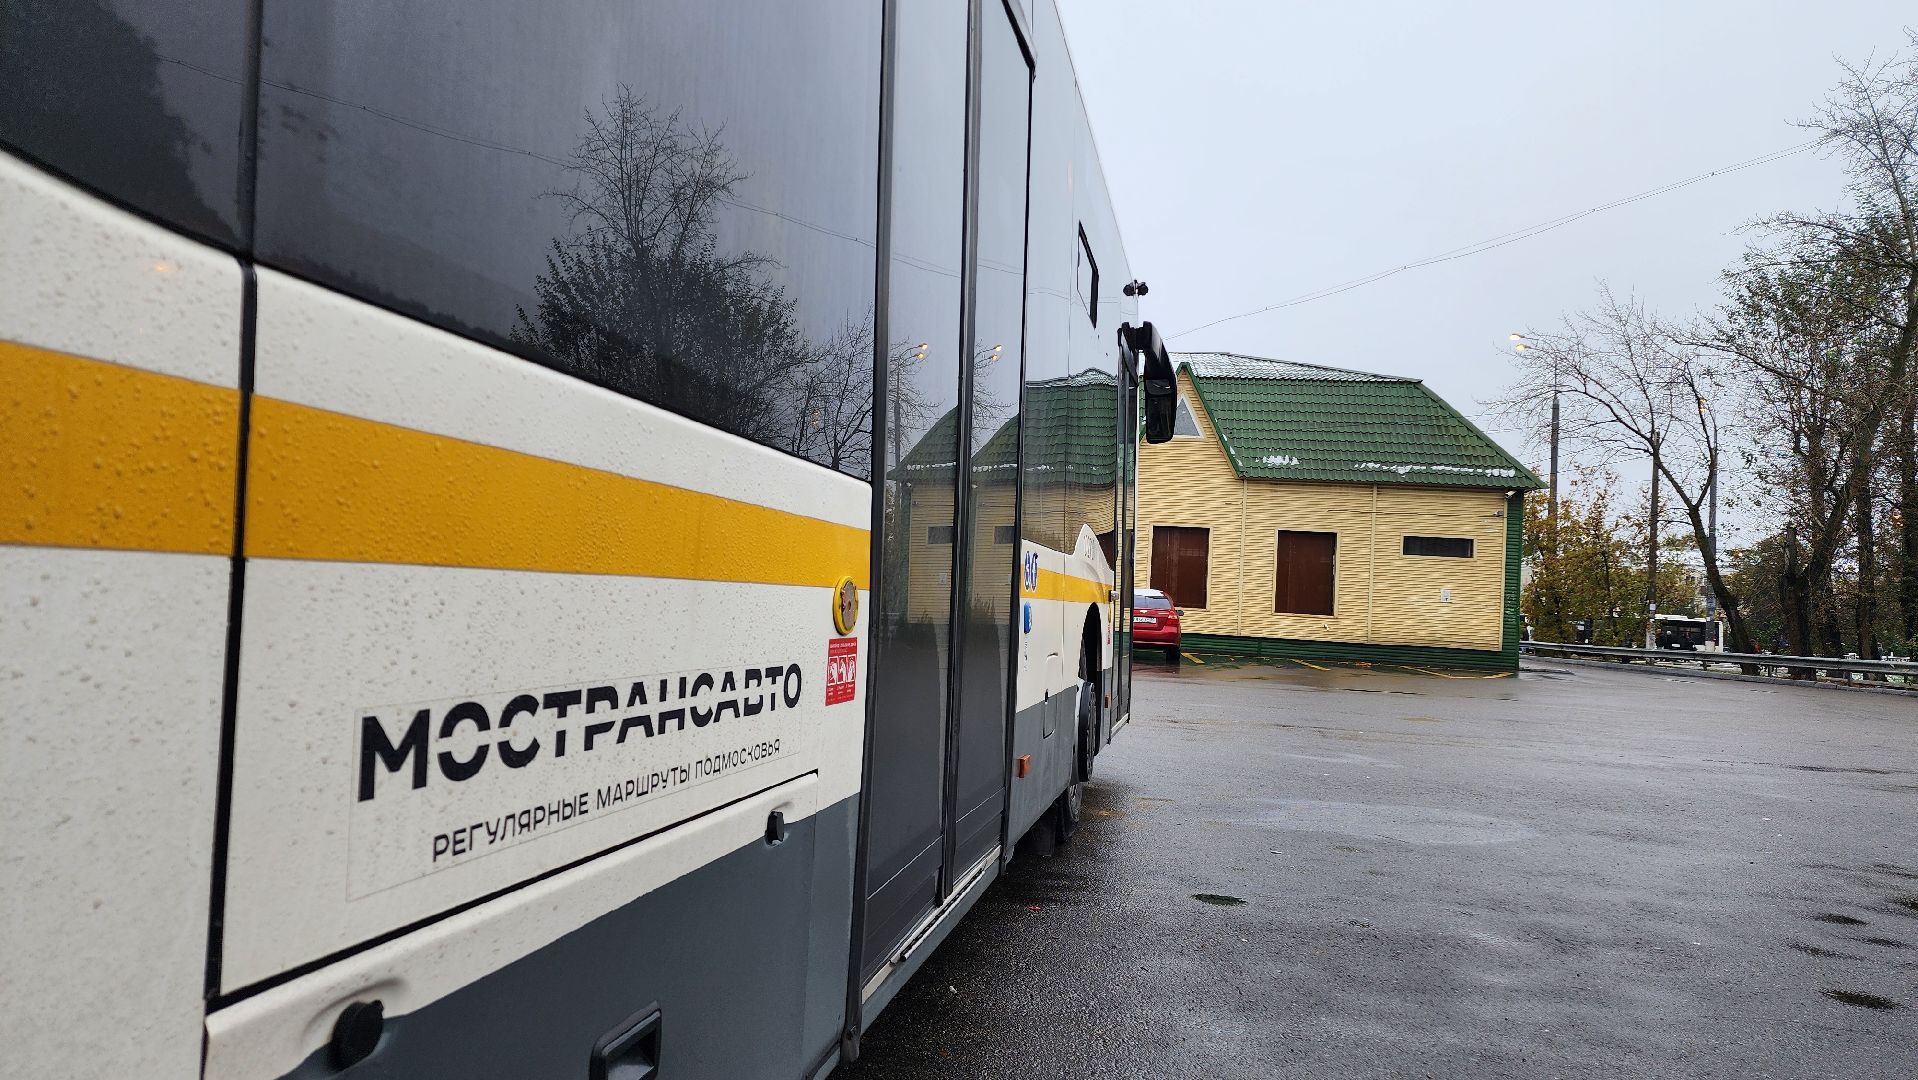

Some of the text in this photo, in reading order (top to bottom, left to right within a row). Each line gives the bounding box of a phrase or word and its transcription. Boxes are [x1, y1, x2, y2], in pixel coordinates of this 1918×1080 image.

[357, 663, 802, 803] МОСТРАНСАВТО
[432, 738, 782, 863] РЕГУЛЯРНЫЕ МАРШРУТЫ ПОДМОСКОВЬЯ
